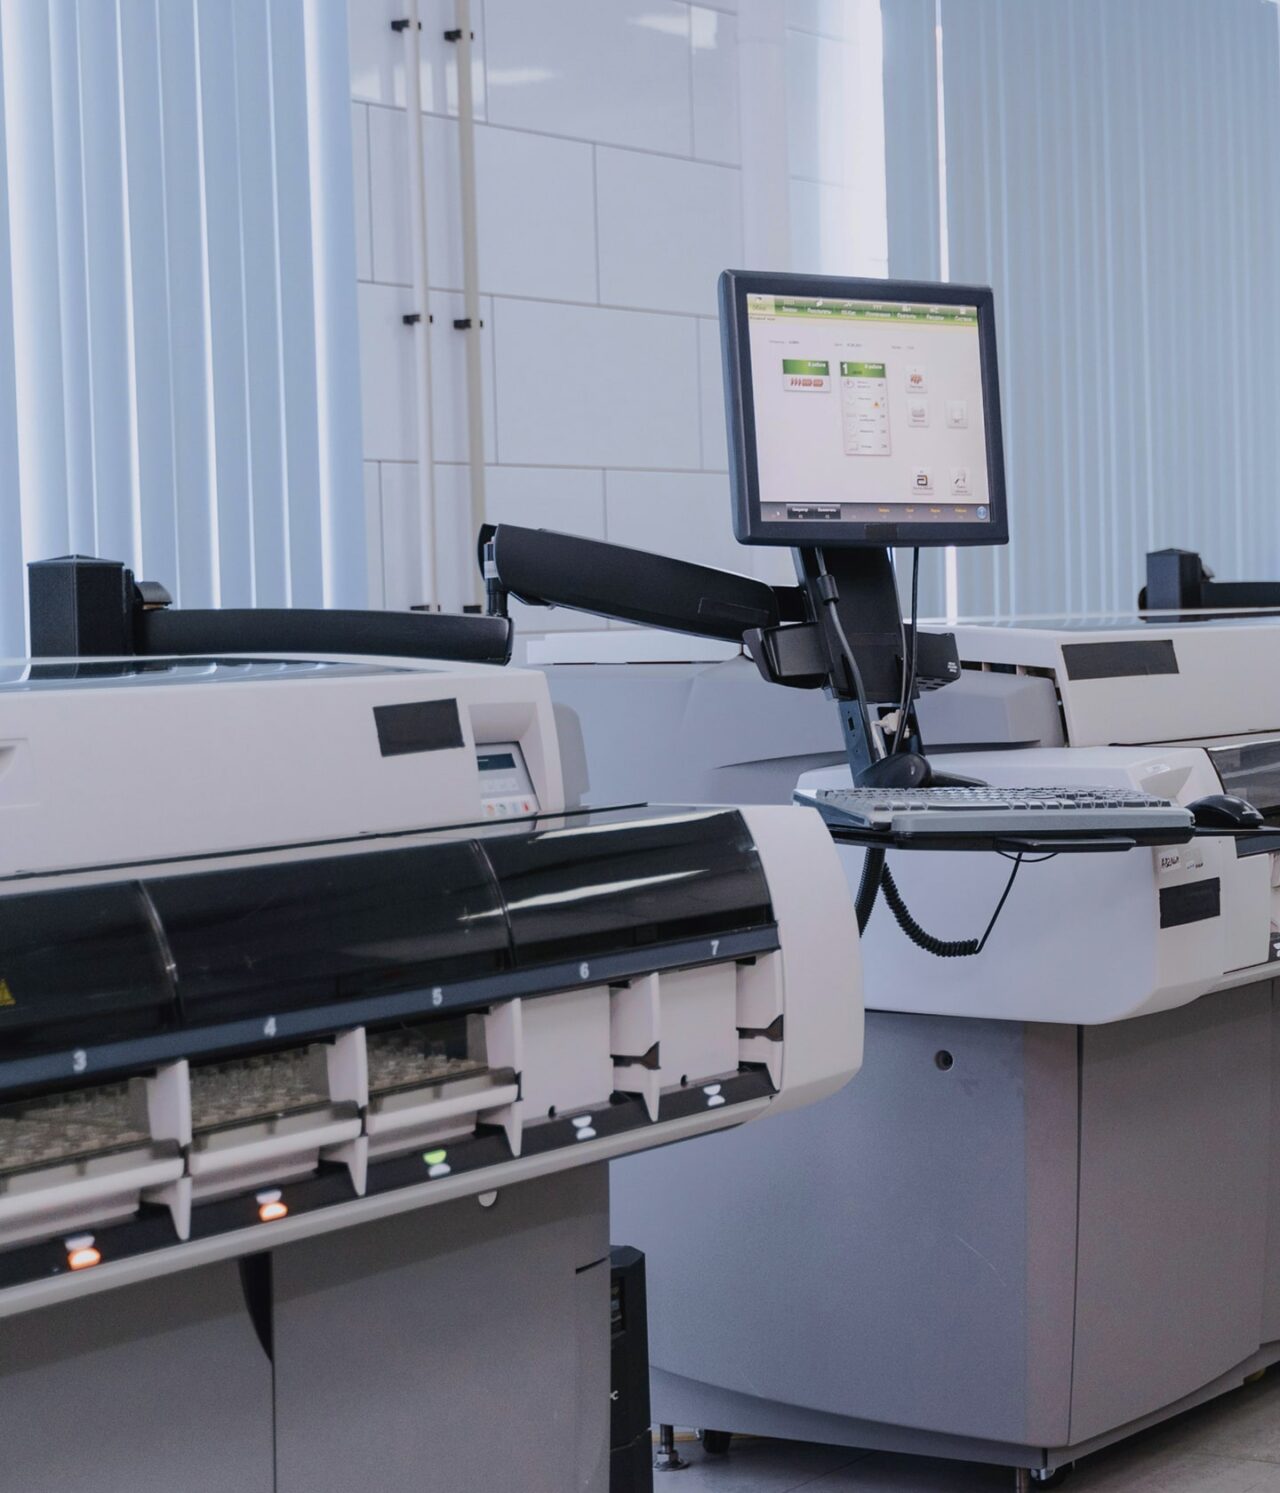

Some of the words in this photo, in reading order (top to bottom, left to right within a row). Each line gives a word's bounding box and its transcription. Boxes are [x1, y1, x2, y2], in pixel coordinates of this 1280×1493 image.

[842, 363, 848, 375] 1
[710, 940, 720, 956] 7
[579, 962, 590, 979] 6
[431, 987, 443, 1006] 5
[263, 1017, 277, 1037] 4
[73, 1049, 87, 1072] 3
